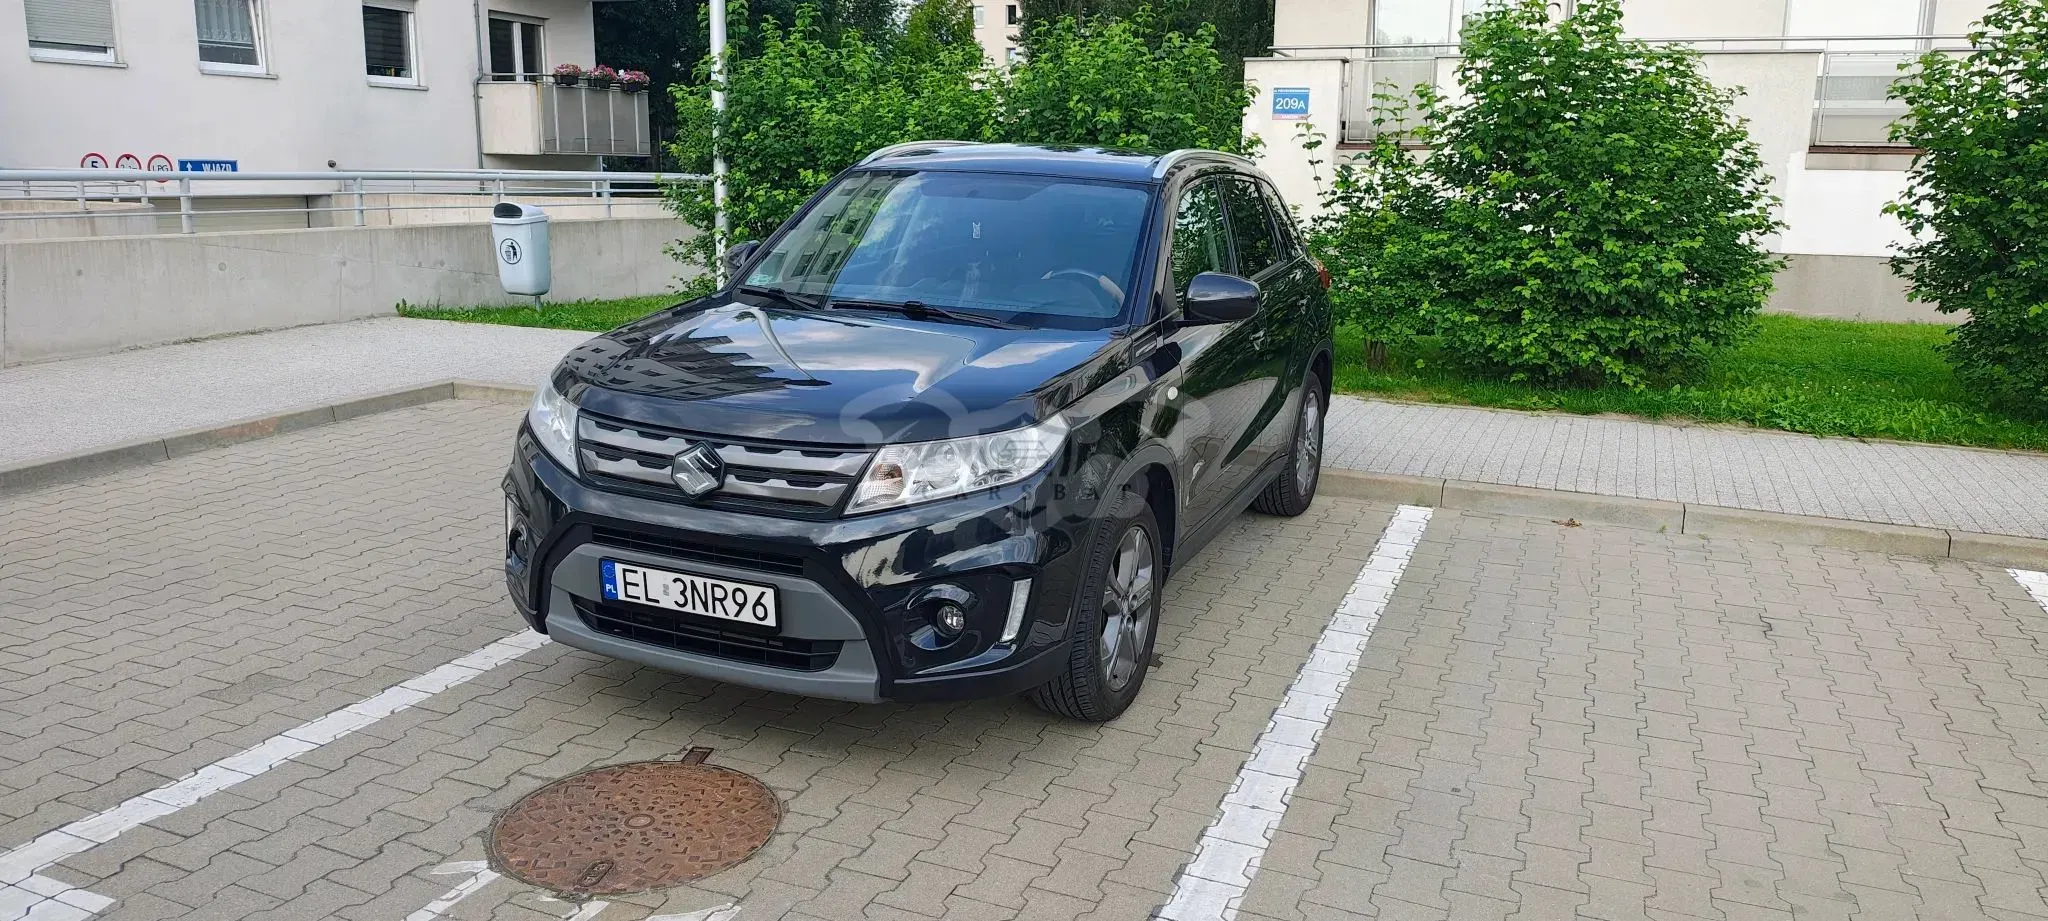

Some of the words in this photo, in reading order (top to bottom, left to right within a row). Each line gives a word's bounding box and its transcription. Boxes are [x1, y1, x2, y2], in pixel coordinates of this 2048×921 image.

[1275, 97, 1305, 109] 209A
[201, 163, 232, 172] WJAZD
[605, 583, 617, 594] PL
[622, 568, 660, 603] EL
[672, 578, 768, 621] 3NR96
